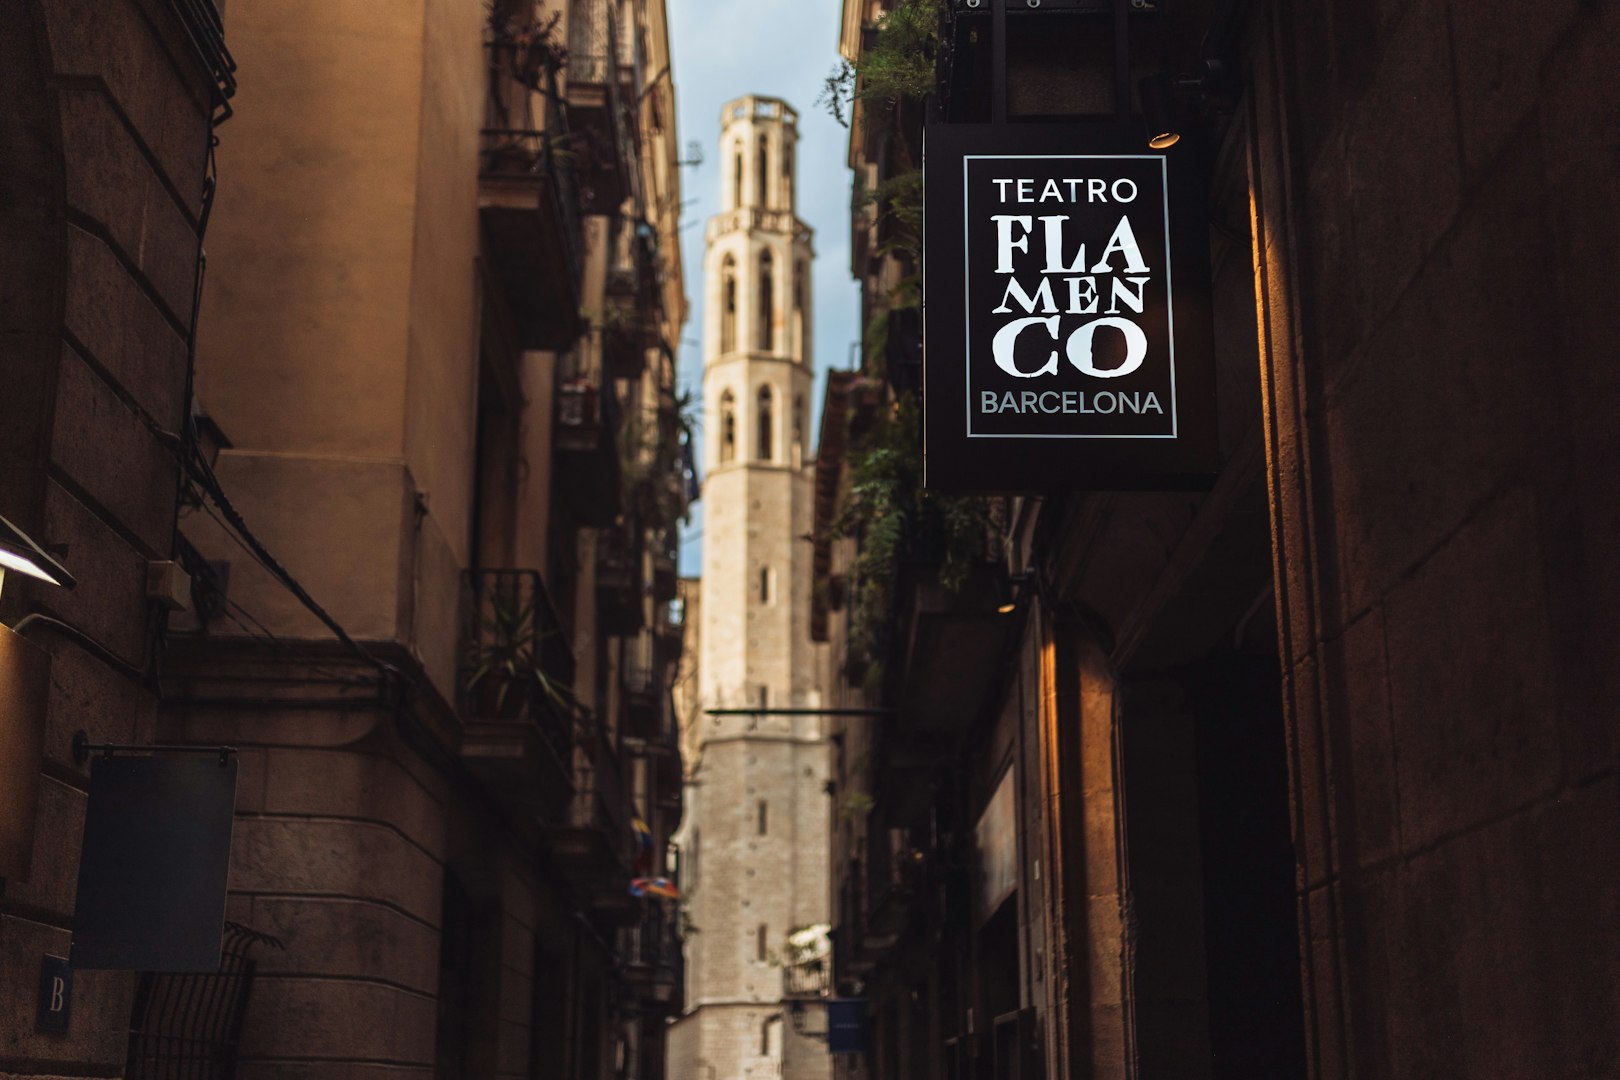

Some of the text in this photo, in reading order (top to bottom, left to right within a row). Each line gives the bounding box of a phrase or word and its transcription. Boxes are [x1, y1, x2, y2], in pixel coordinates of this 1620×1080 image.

[992, 178, 1138, 203] TEATRO
[990, 214, 1151, 274] FLA
[991, 276, 1151, 314] MEN
[992, 315, 1148, 379] CO
[981, 391, 1164, 414] BARCELONA
[50, 976, 64, 1012] B
